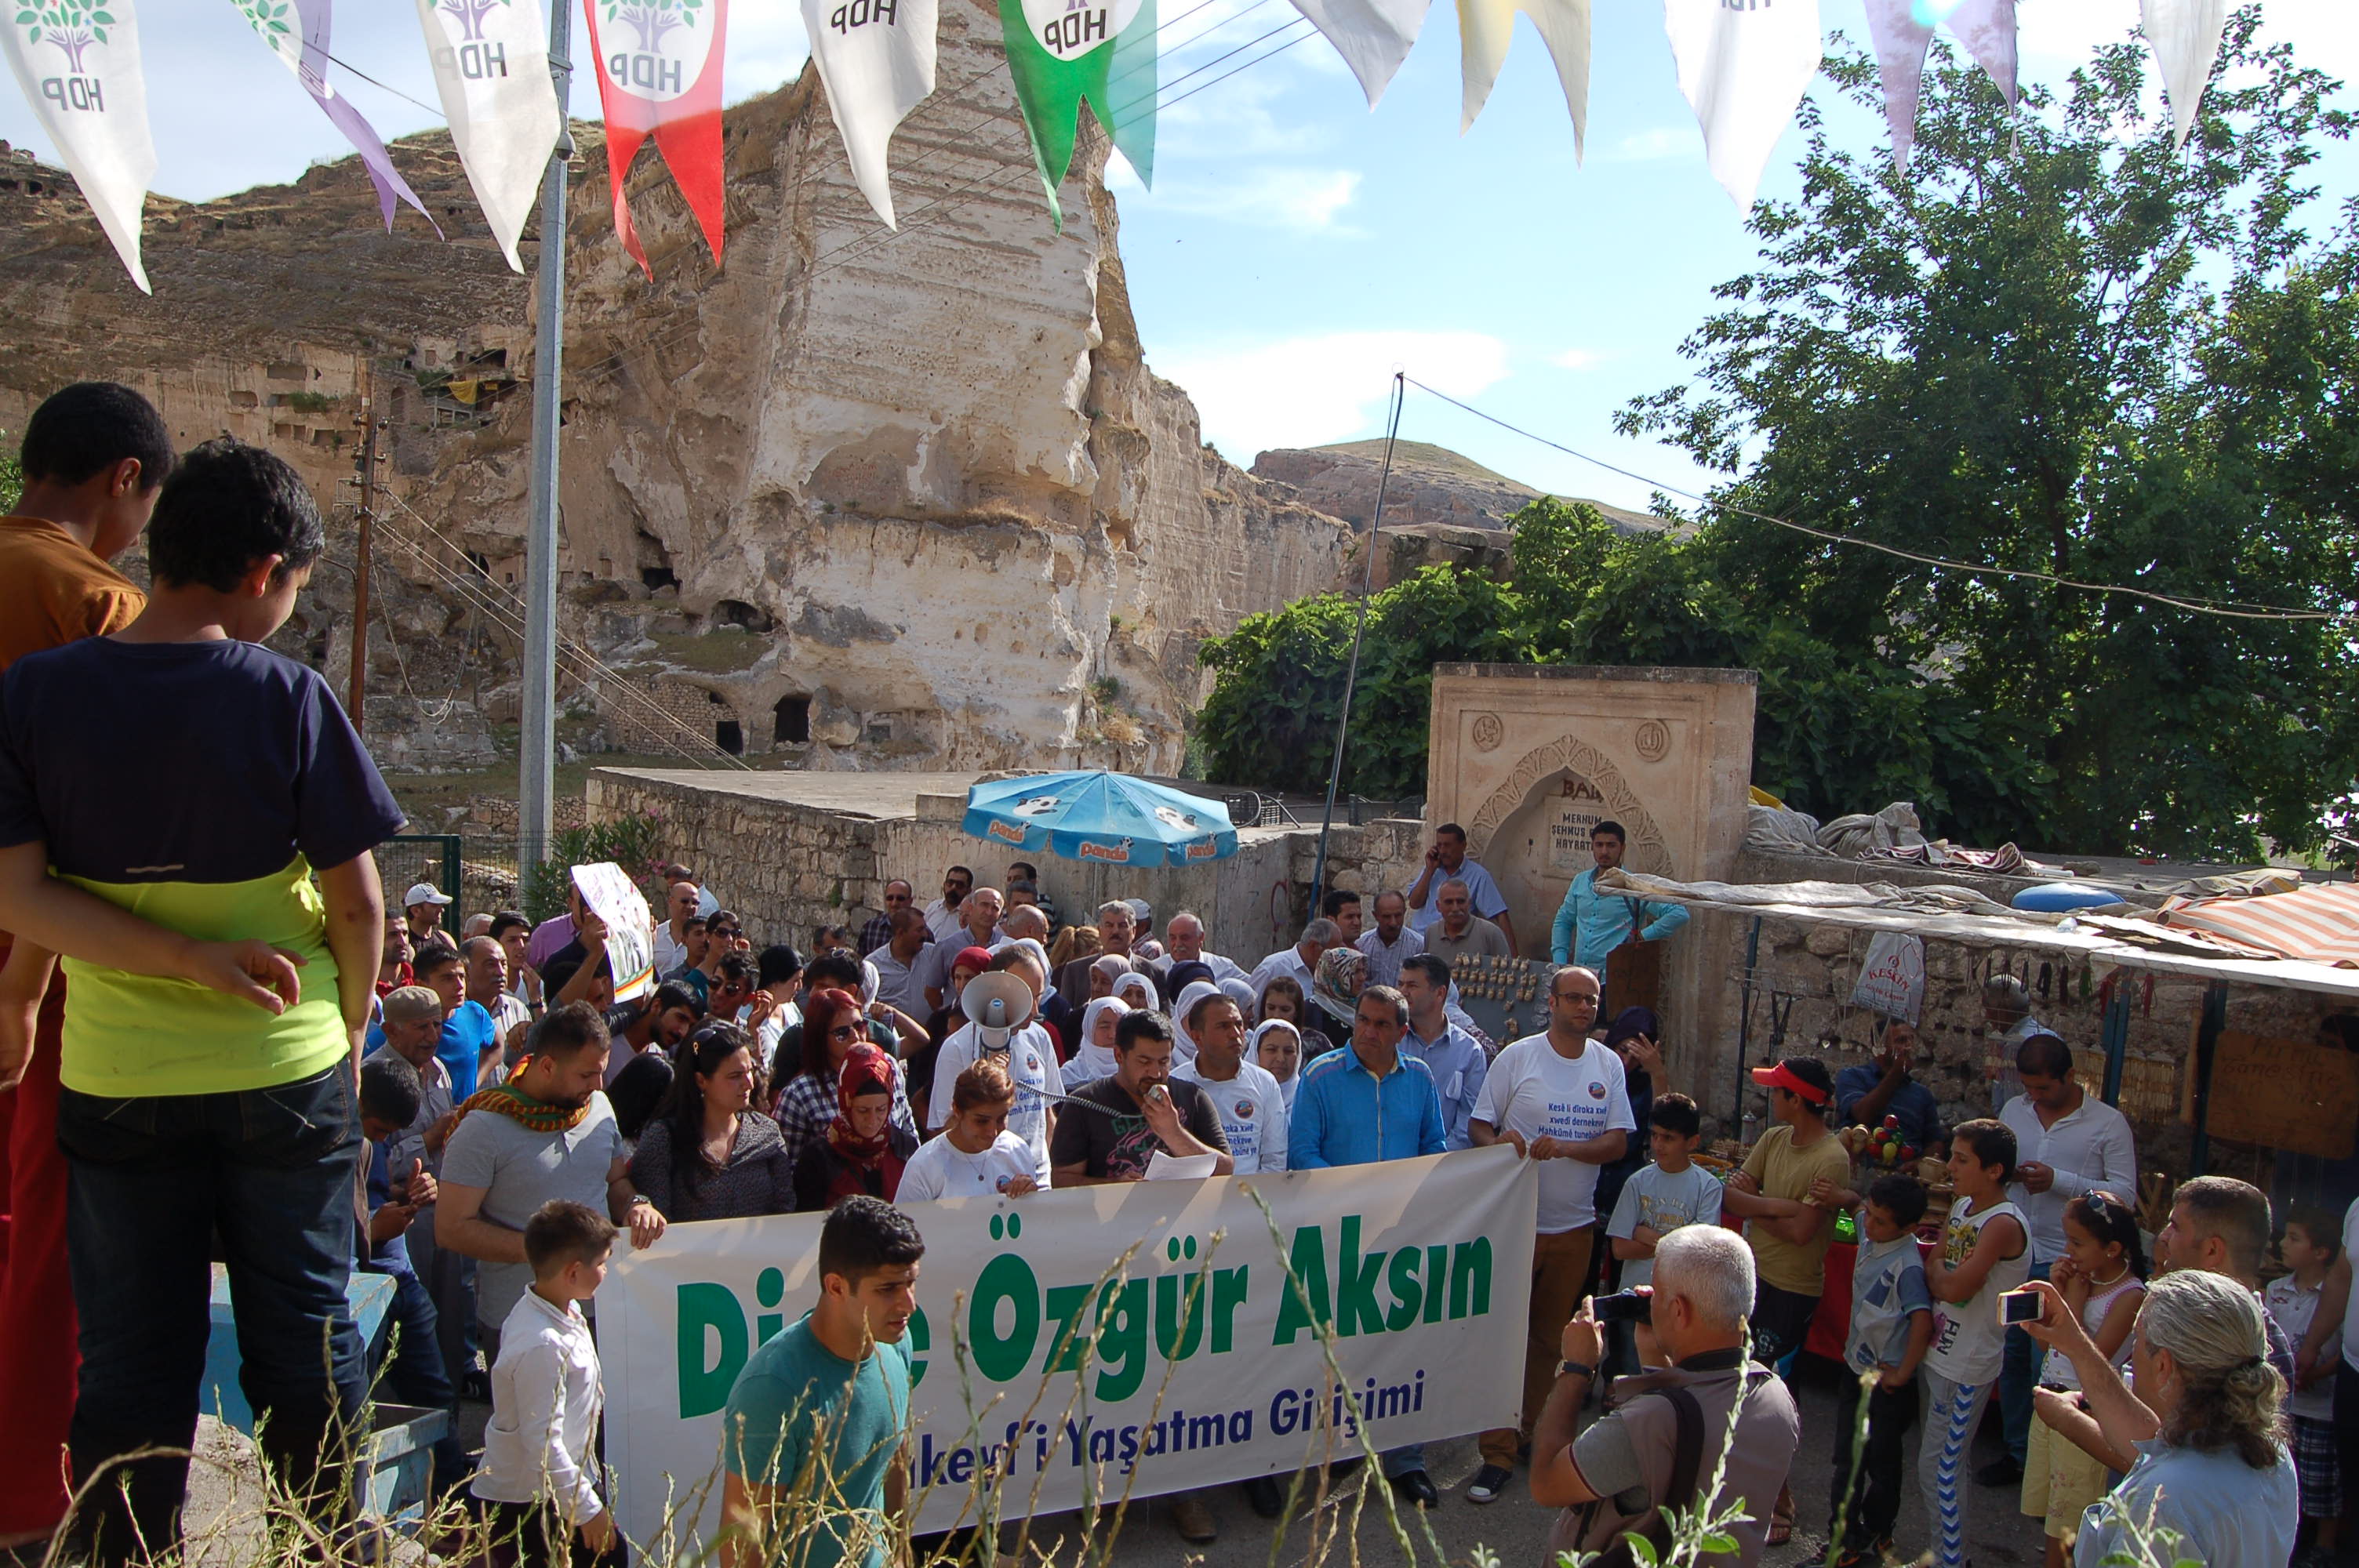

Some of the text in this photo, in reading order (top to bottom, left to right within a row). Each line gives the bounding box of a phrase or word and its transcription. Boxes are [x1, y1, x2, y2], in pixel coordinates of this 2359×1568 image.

[969, 1211, 1249, 1403] Özgür
[1271, 1214, 1492, 1346] Aksın
[1066, 1409, 1253, 1475] Yaşatma
